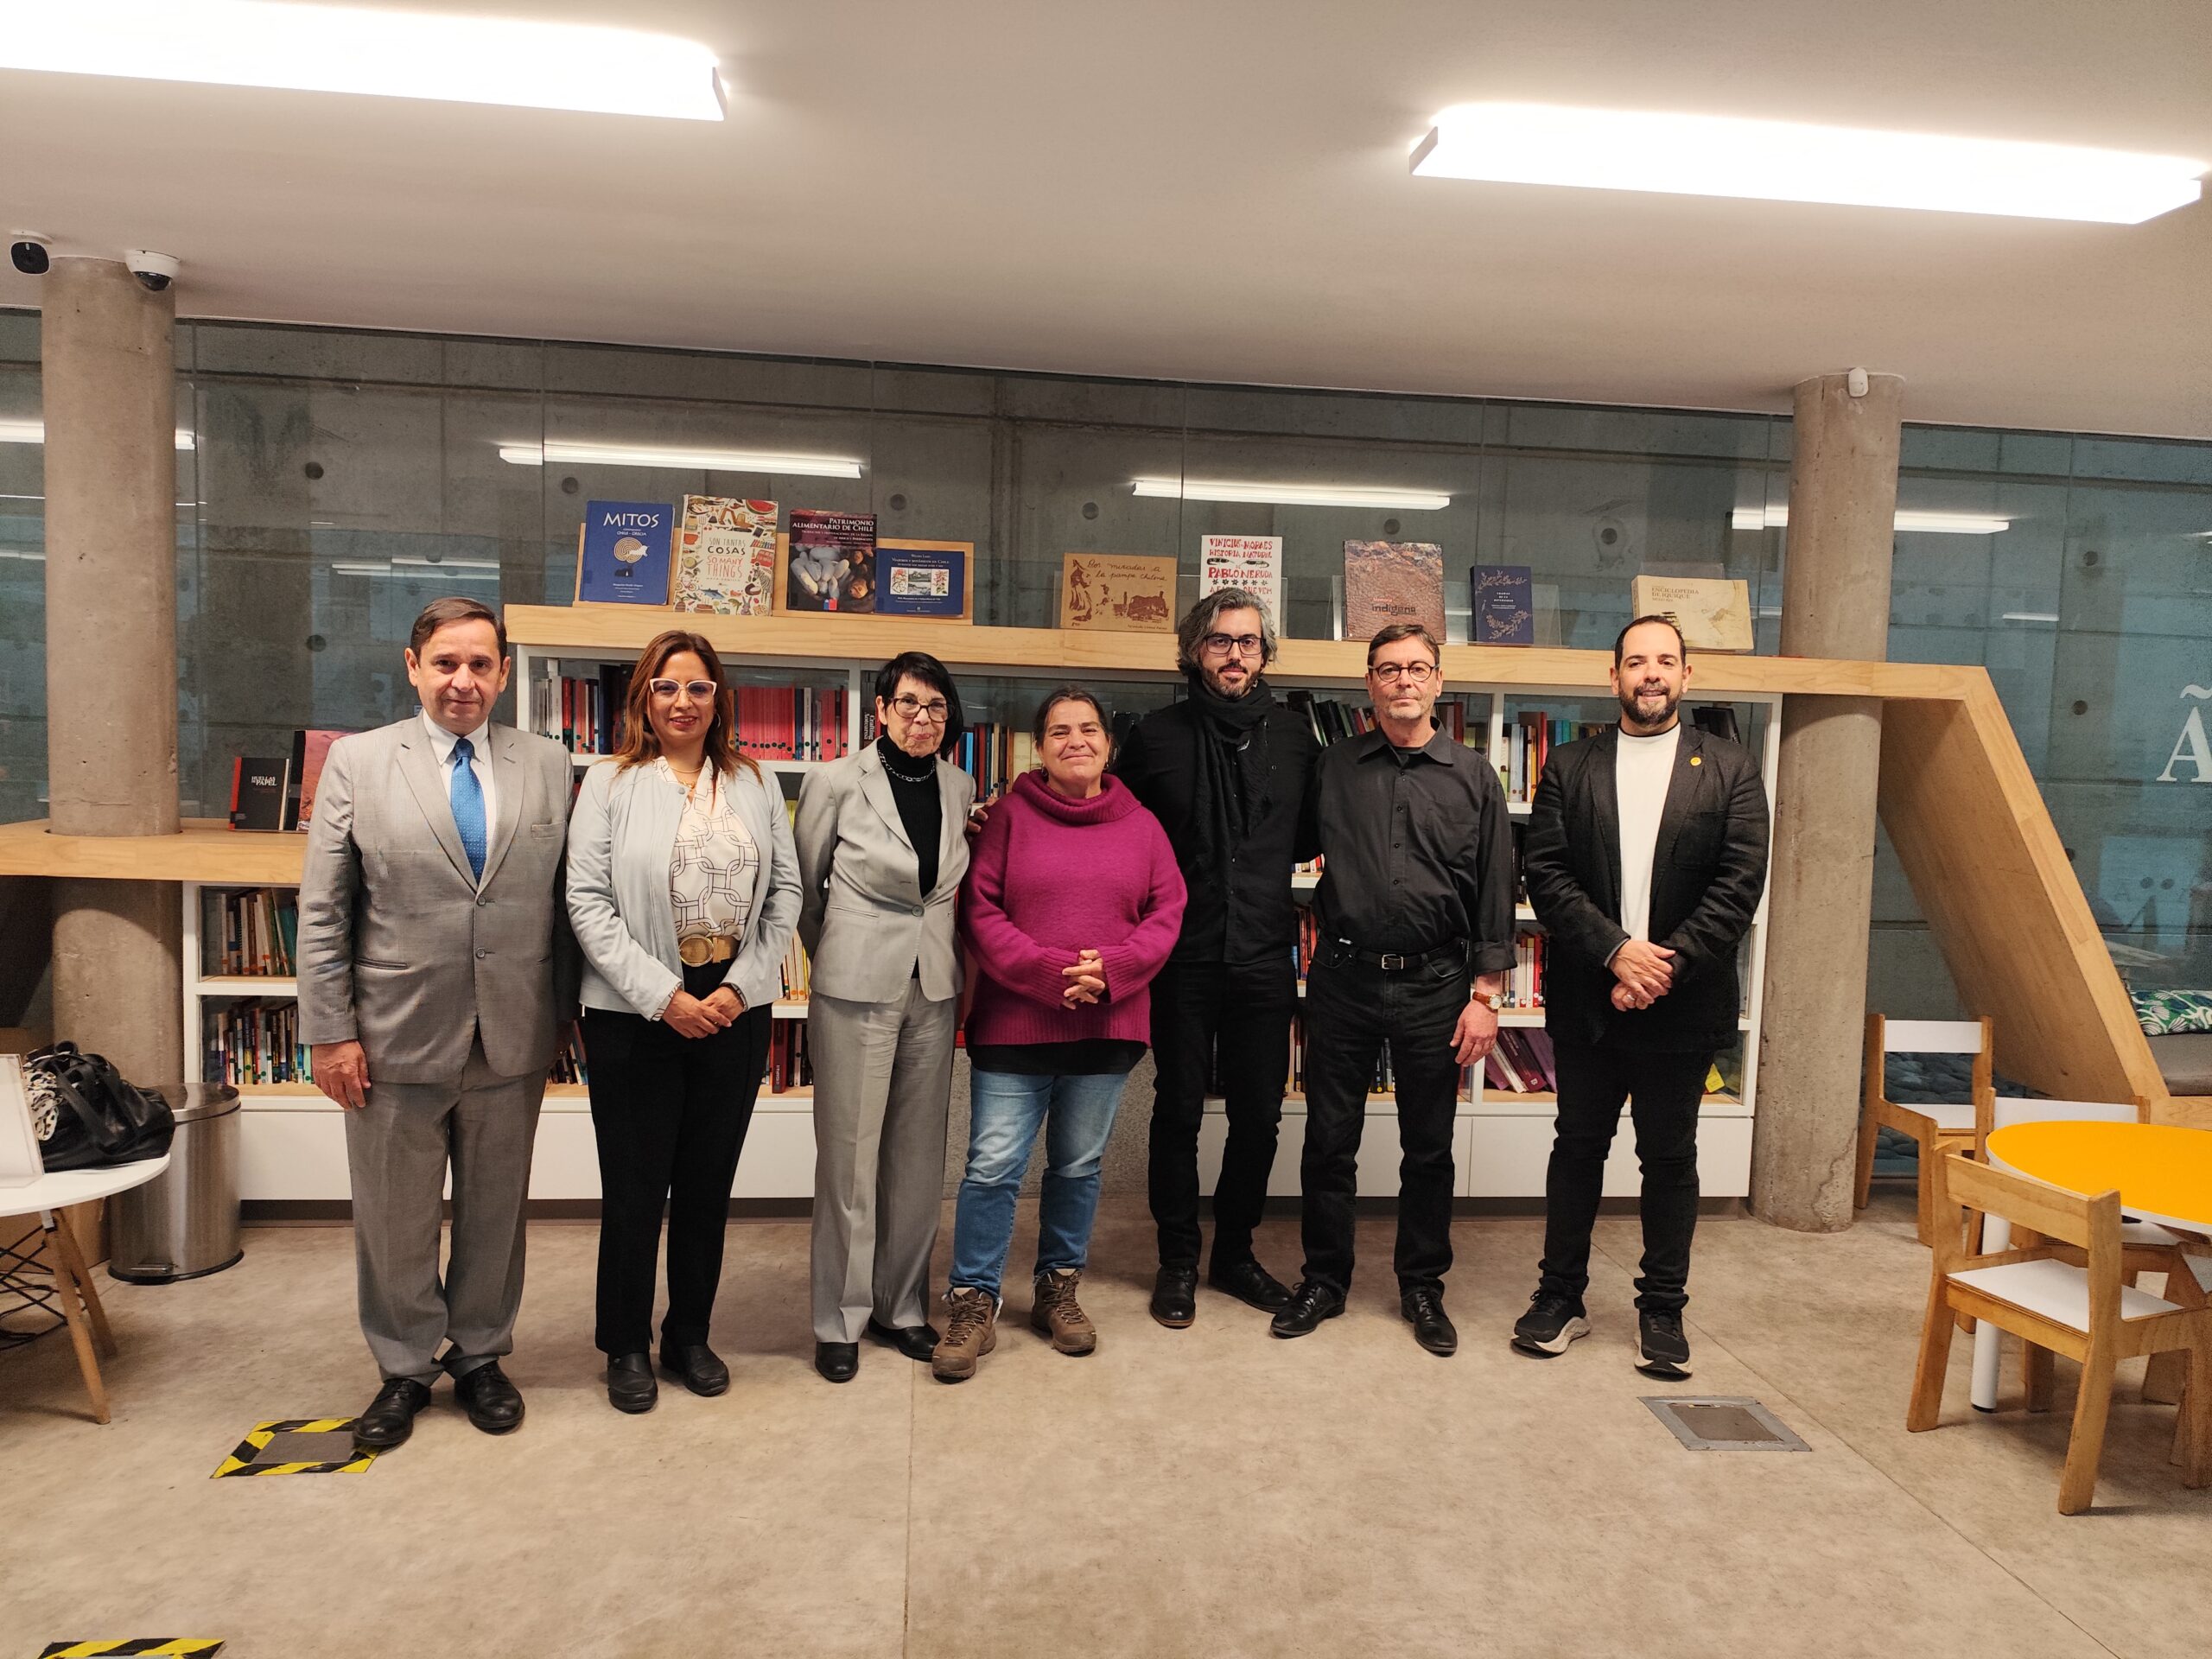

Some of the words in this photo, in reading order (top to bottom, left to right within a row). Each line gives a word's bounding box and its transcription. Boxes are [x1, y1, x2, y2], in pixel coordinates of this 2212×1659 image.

[603, 512, 659, 528] MITOS
[829, 518, 874, 526] PATRIMONIO
[792, 522, 841, 531] ALIMENTARIO
[709, 537, 721, 546] SON
[723, 538, 746, 547] TANTAS
[1209, 538, 1242, 549] VINICIUS
[1243, 541, 1273, 550] MORAES
[708, 546, 746, 556] COSAS
[1209, 549, 1242, 558] HISTORIA
[719, 556, 744, 565] MANY
[708, 563, 742, 578] THINGS
[1208, 567, 1240, 578] PABLO
[1241, 569, 1273, 579] NERUDA
[2156, 684, 2212, 783] Ã
